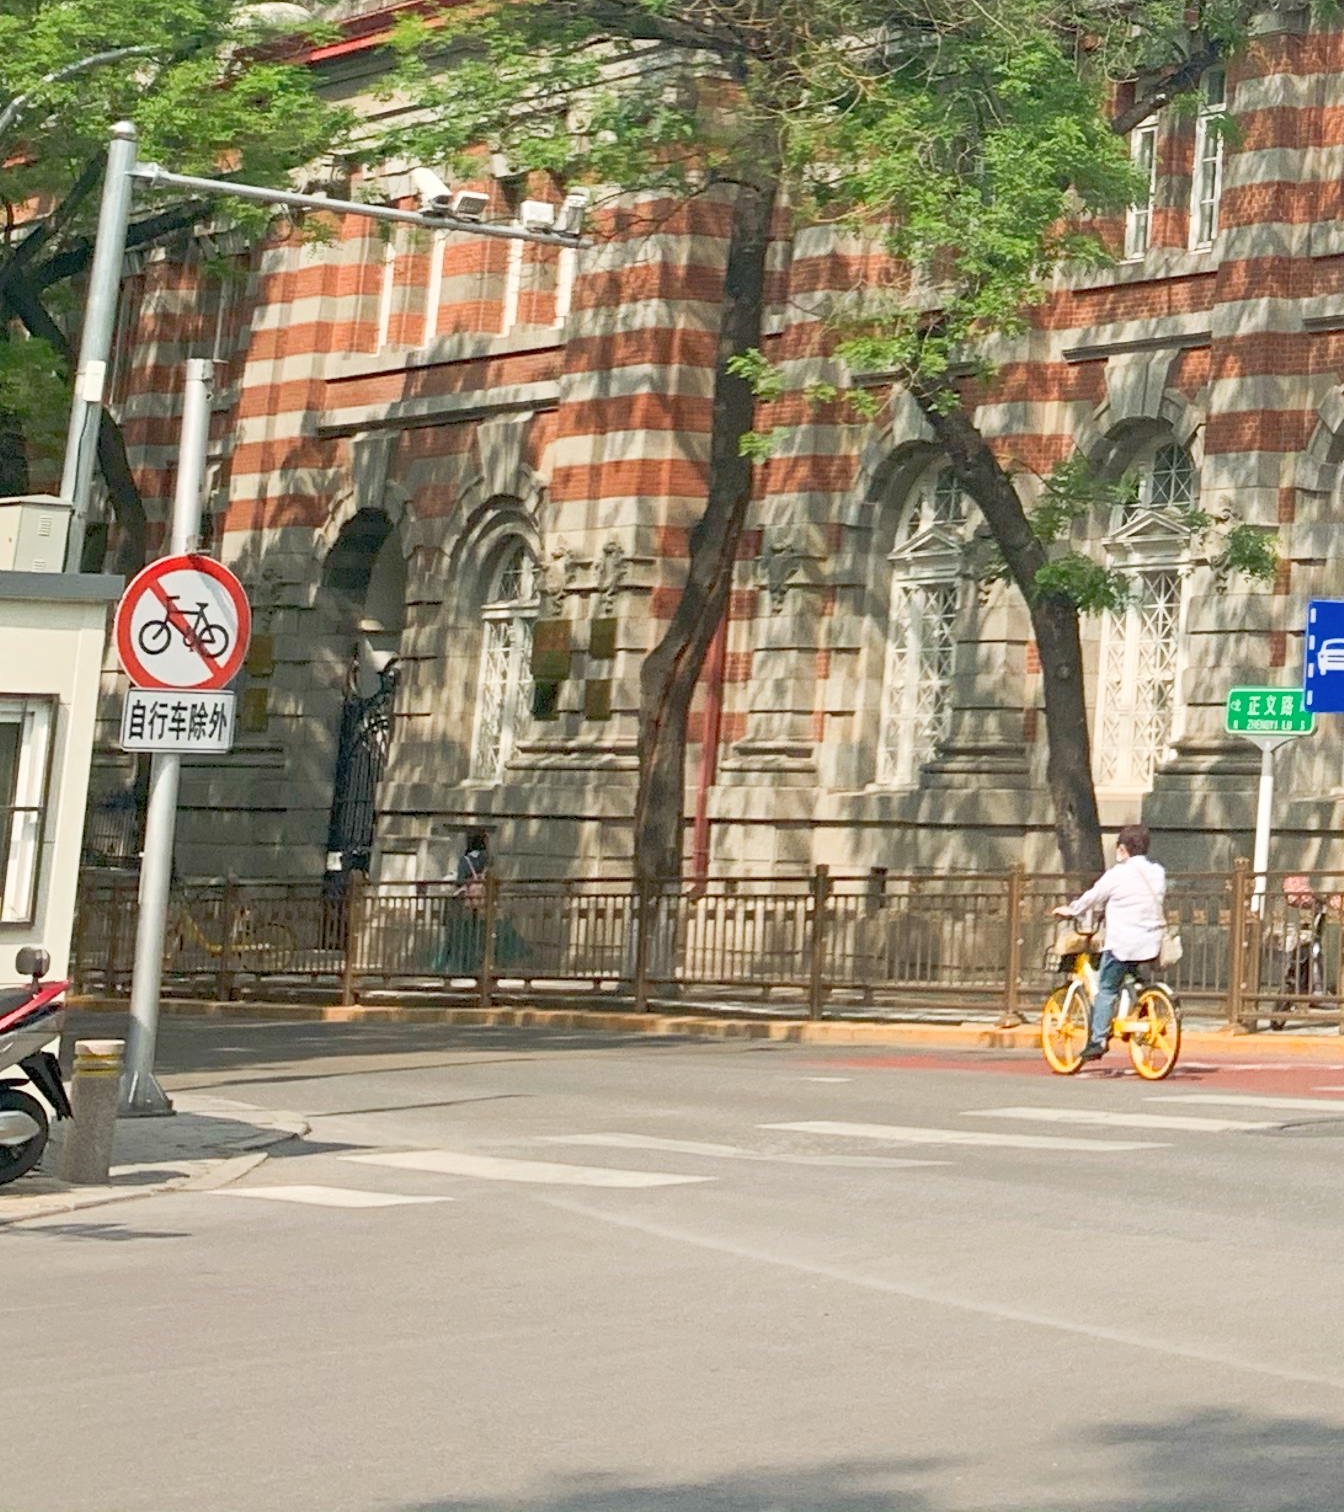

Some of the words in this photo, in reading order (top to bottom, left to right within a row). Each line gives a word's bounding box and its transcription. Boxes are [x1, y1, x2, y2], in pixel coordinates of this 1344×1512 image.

[128, 699, 227, 742] 自行车除外
[1246, 694, 1295, 716] 正义路
